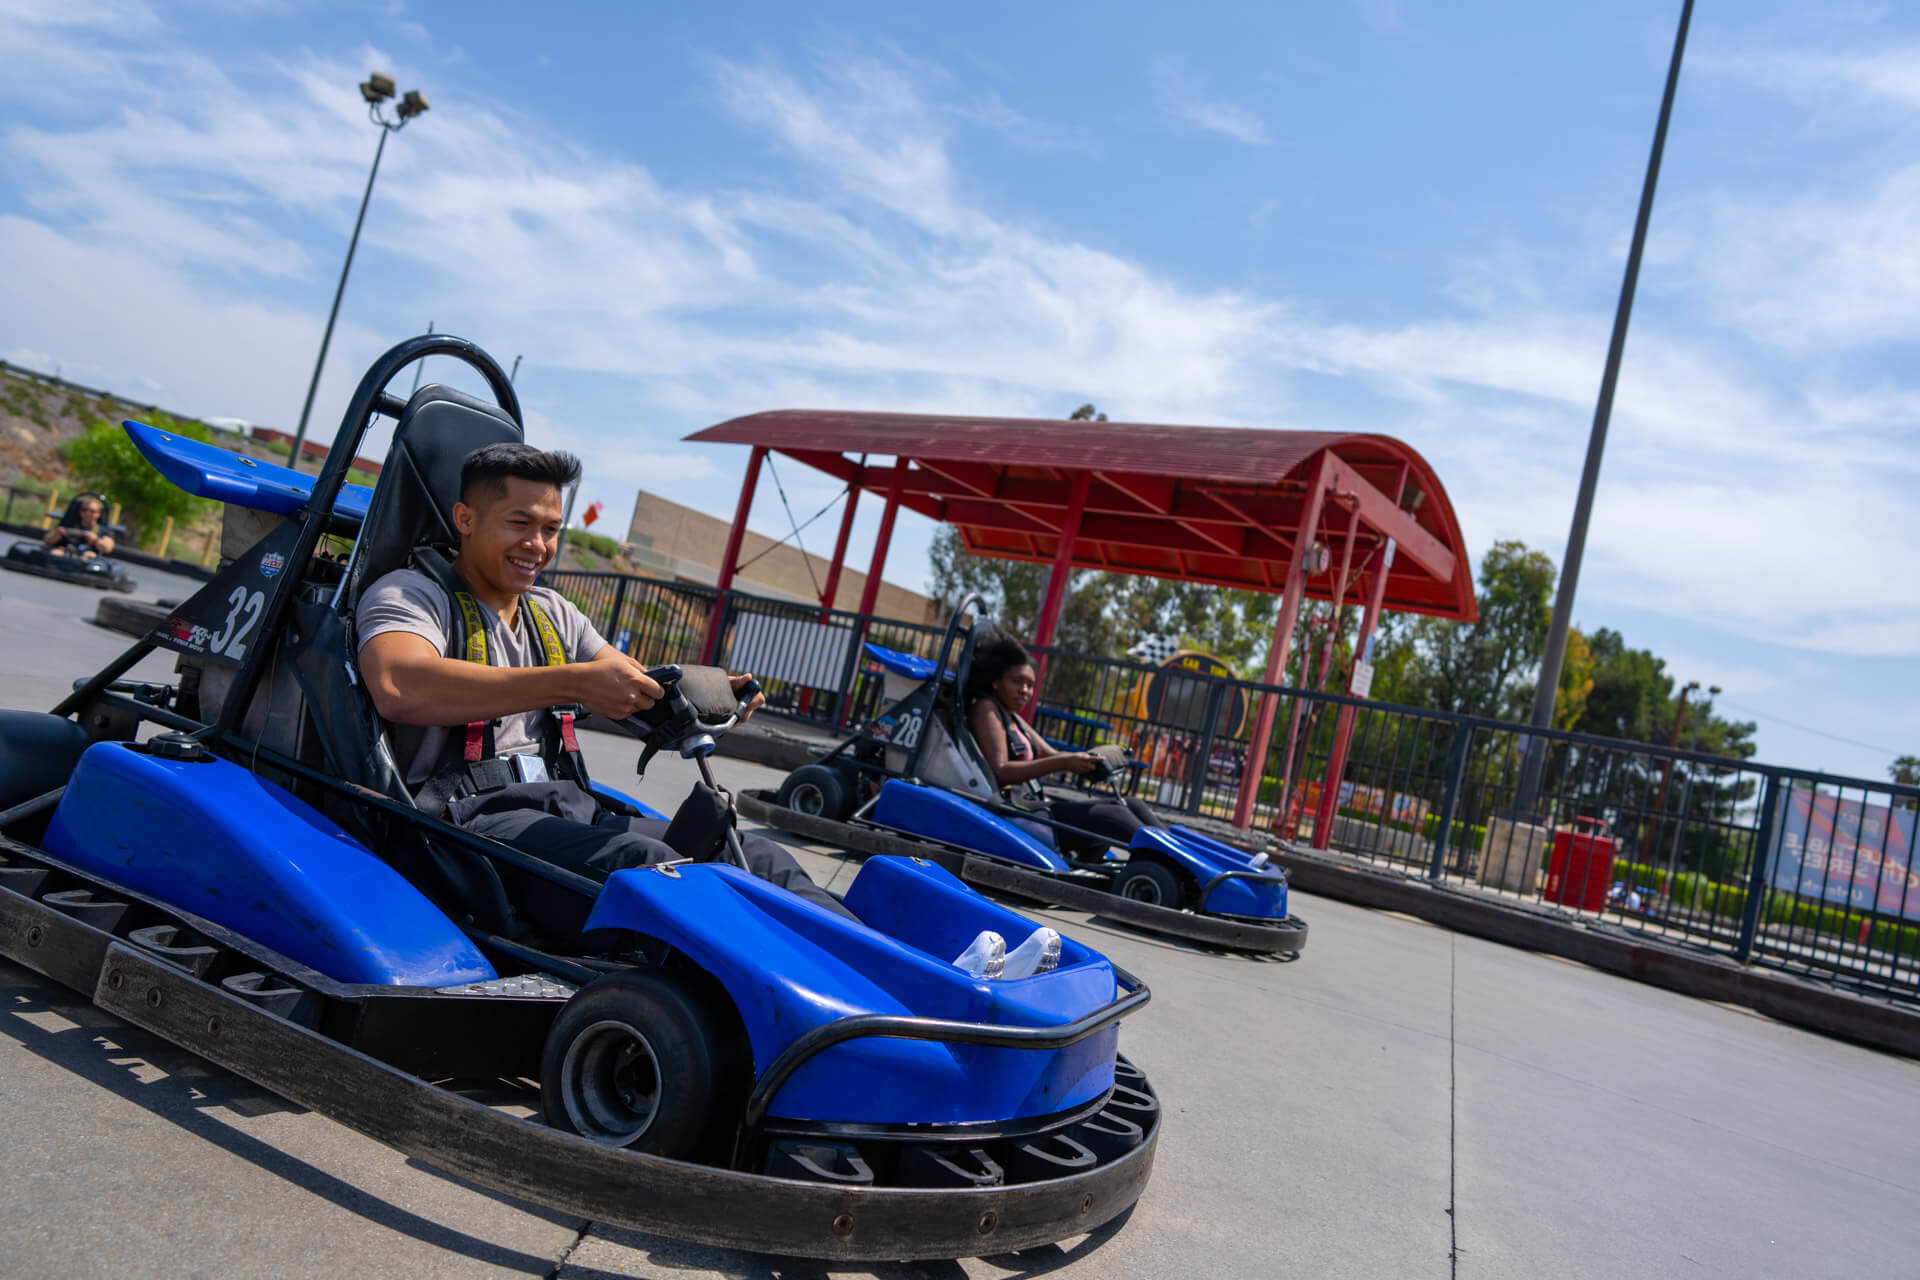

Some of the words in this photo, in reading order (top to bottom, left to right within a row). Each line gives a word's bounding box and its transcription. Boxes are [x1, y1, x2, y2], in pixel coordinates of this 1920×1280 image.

[210, 586, 264, 660] 32
[1183, 657, 1199, 670] CAR
[892, 712, 922, 748] 28
